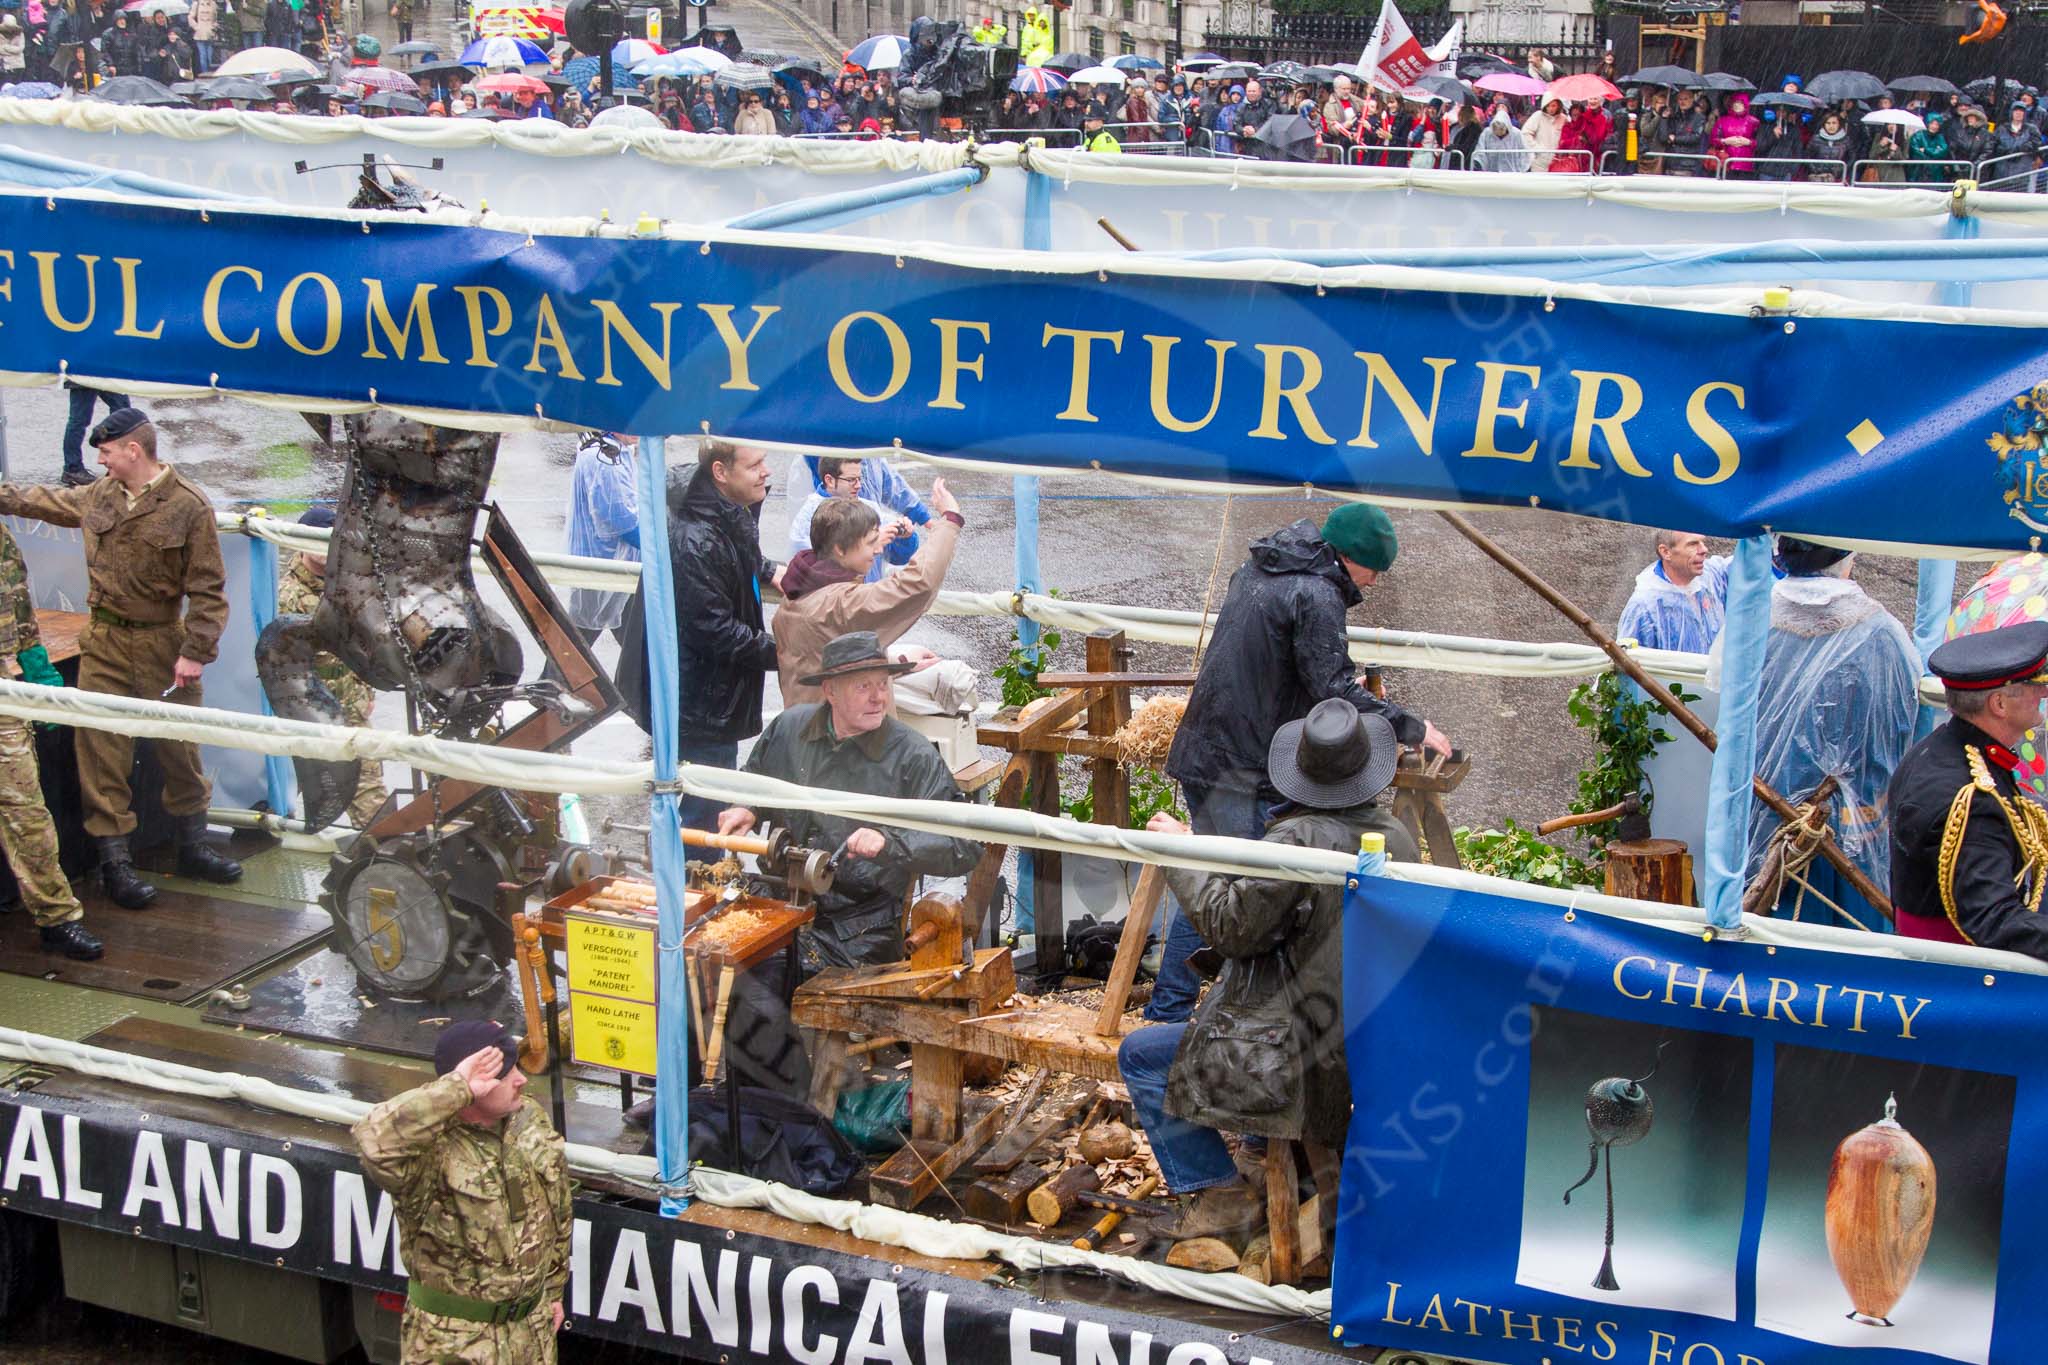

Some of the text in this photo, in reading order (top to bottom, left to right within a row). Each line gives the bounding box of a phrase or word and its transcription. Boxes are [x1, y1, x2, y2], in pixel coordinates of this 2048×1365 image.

[205, 266, 780, 390] COMPANY
[828, 311, 990, 409] OF
[1042, 324, 1746, 485] TURNERS
[583, 943, 639, 958] VERSCHOYLE
[586, 1004, 640, 1020] HAND LATHE
[597, 1020, 615, 1029] CIRCA
[1612, 955, 1933, 1041] CHARITY
[121, 1129, 303, 1249] AND
[1381, 1281, 1618, 1361] LATHES
